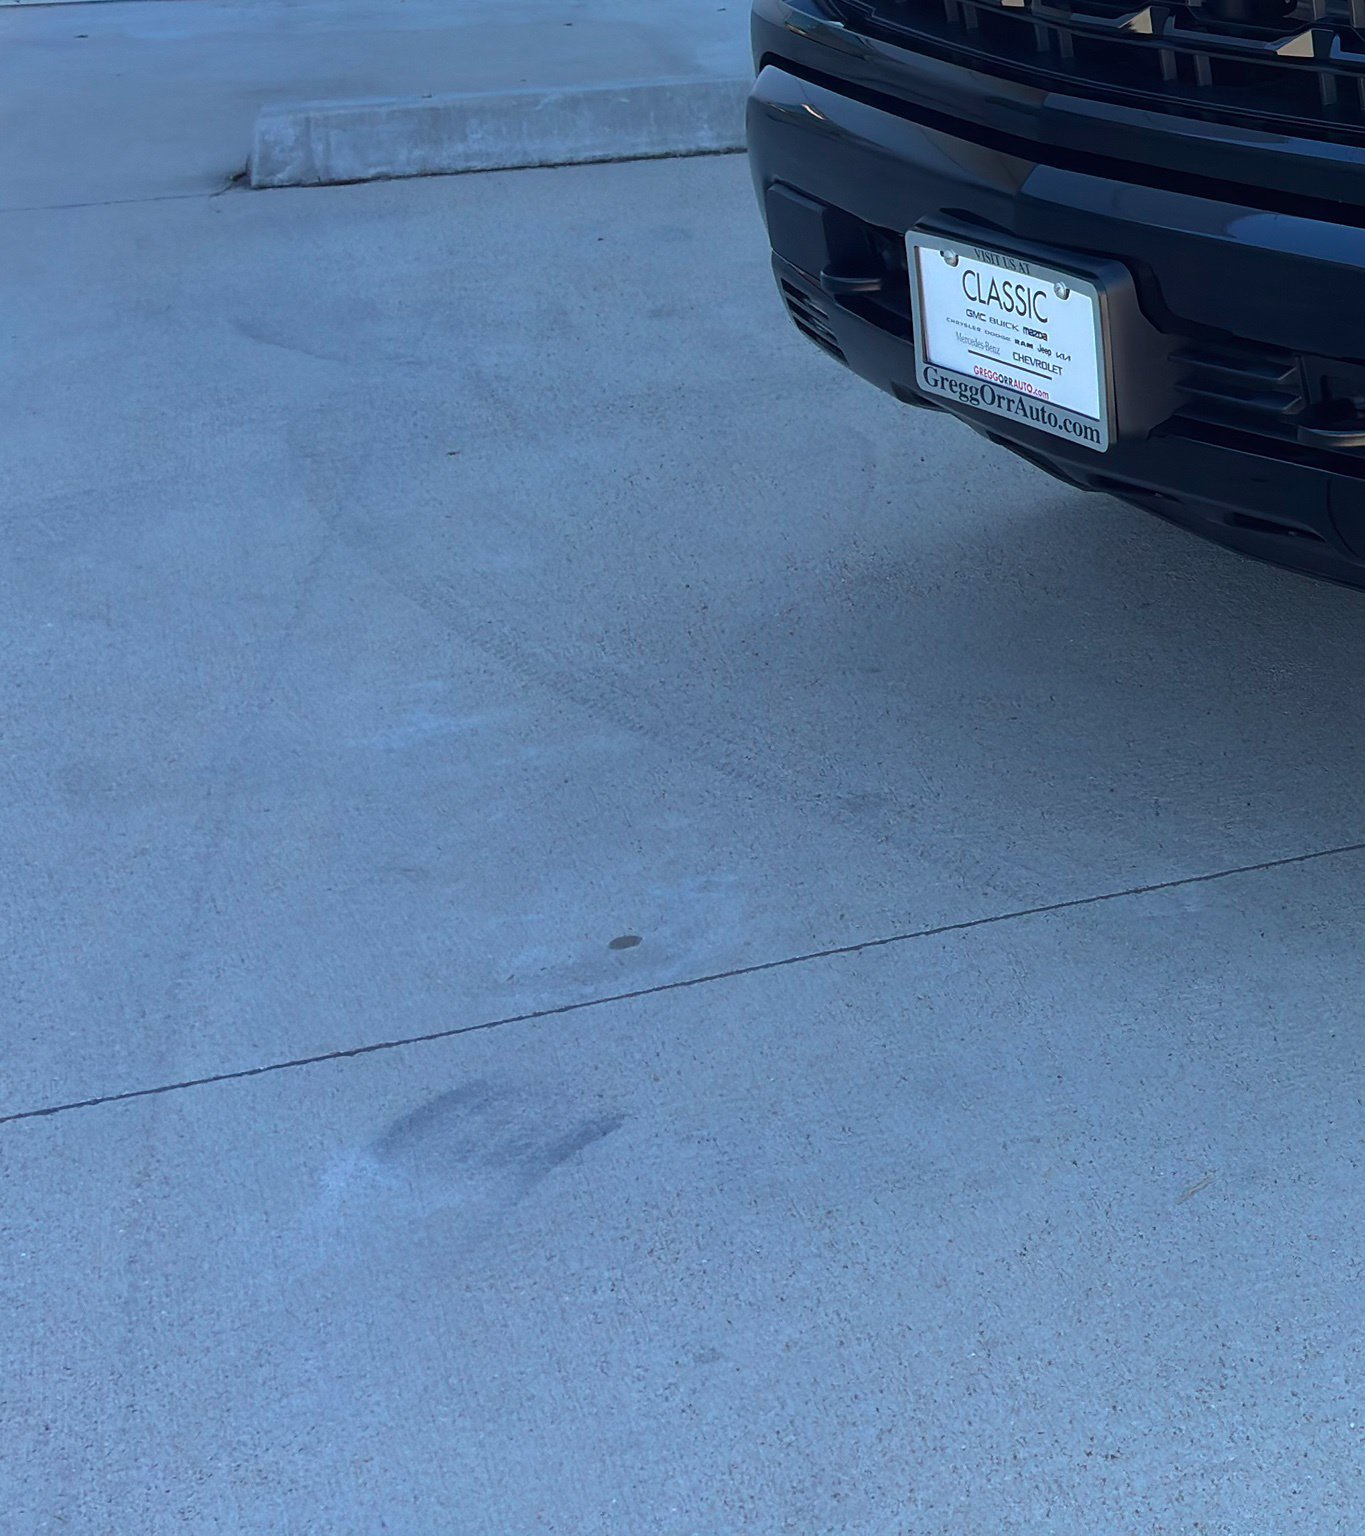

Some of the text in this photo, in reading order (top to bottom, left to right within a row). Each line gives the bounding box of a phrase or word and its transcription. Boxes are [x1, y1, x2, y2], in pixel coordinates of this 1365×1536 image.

[974, 249, 1031, 275] VISIT US AT
[962, 269, 1048, 323] CLASSIC
[966, 309, 987, 322] GMC
[989, 316, 1019, 332] BUICK
[946, 317, 982, 332] CHRYSLER
[1014, 338, 1034, 349] RAM
[1037, 344, 1053, 357] Jeep
[1013, 351, 1063, 376] CHEVROLET
[973, 366, 1049, 398] GREGGORRAUTO.com
[923, 366, 1101, 444] GreggOrrAuto.com
